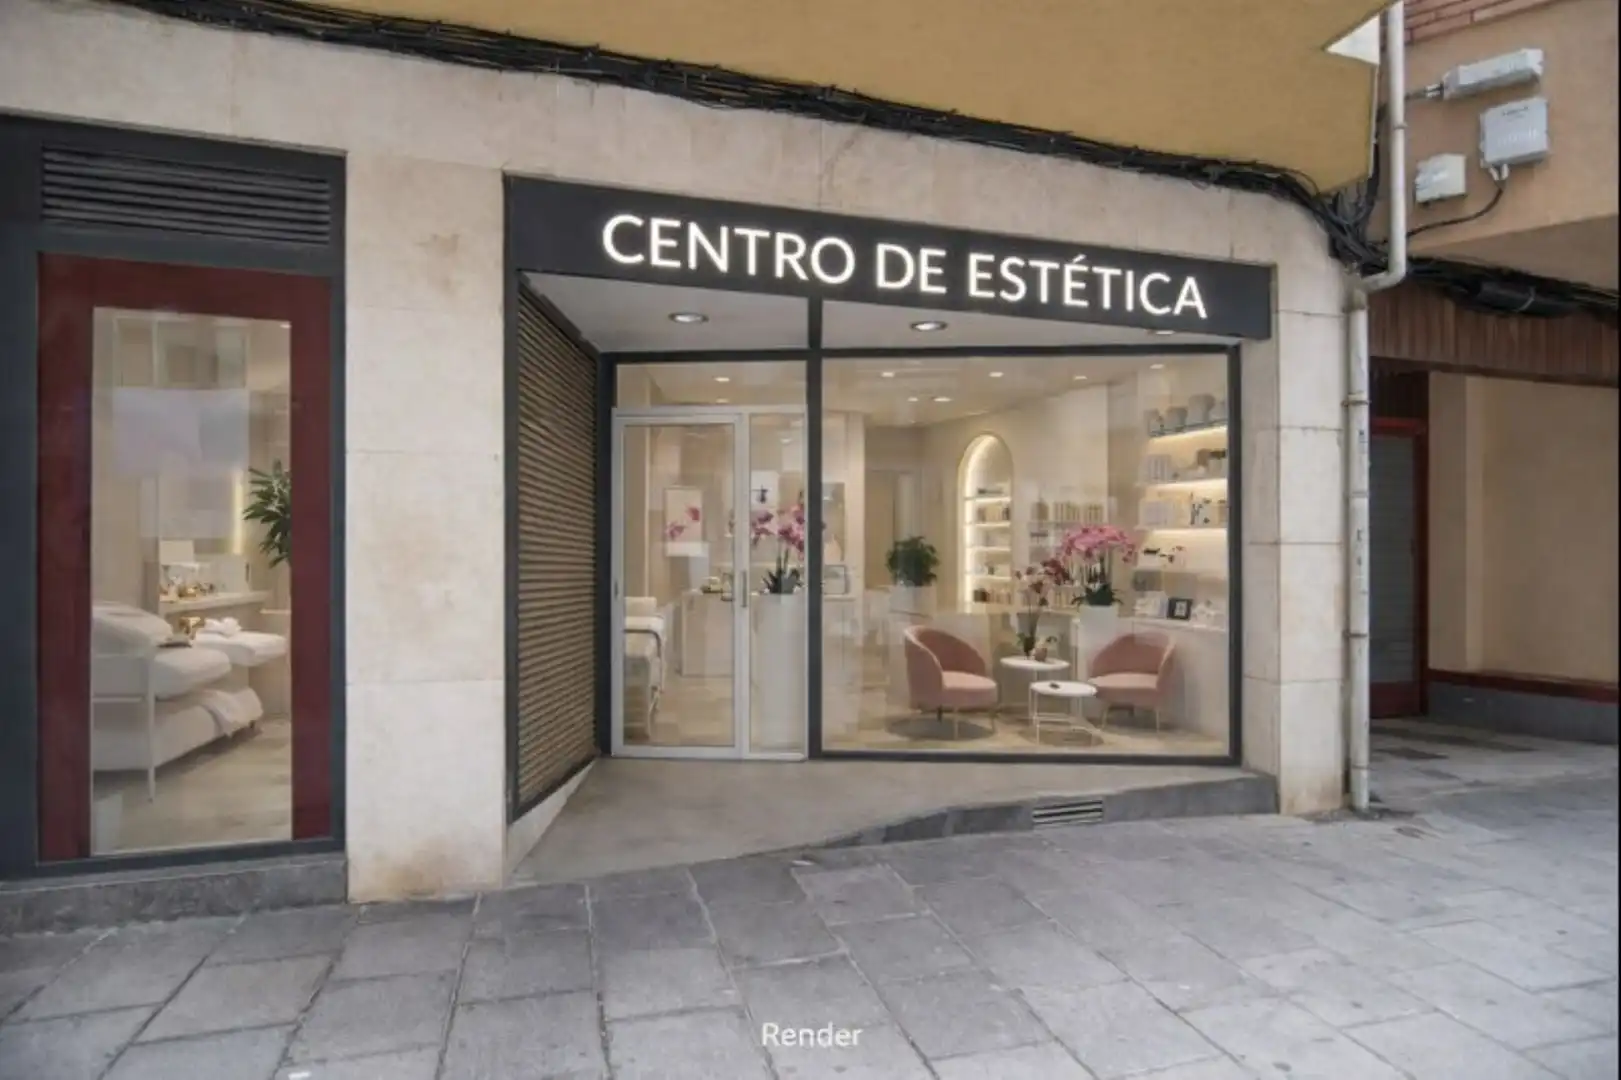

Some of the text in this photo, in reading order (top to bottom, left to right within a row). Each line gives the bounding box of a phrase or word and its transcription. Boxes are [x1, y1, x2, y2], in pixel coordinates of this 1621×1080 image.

[602, 214, 1208, 319] CENTRO DE ESTÉTICA
